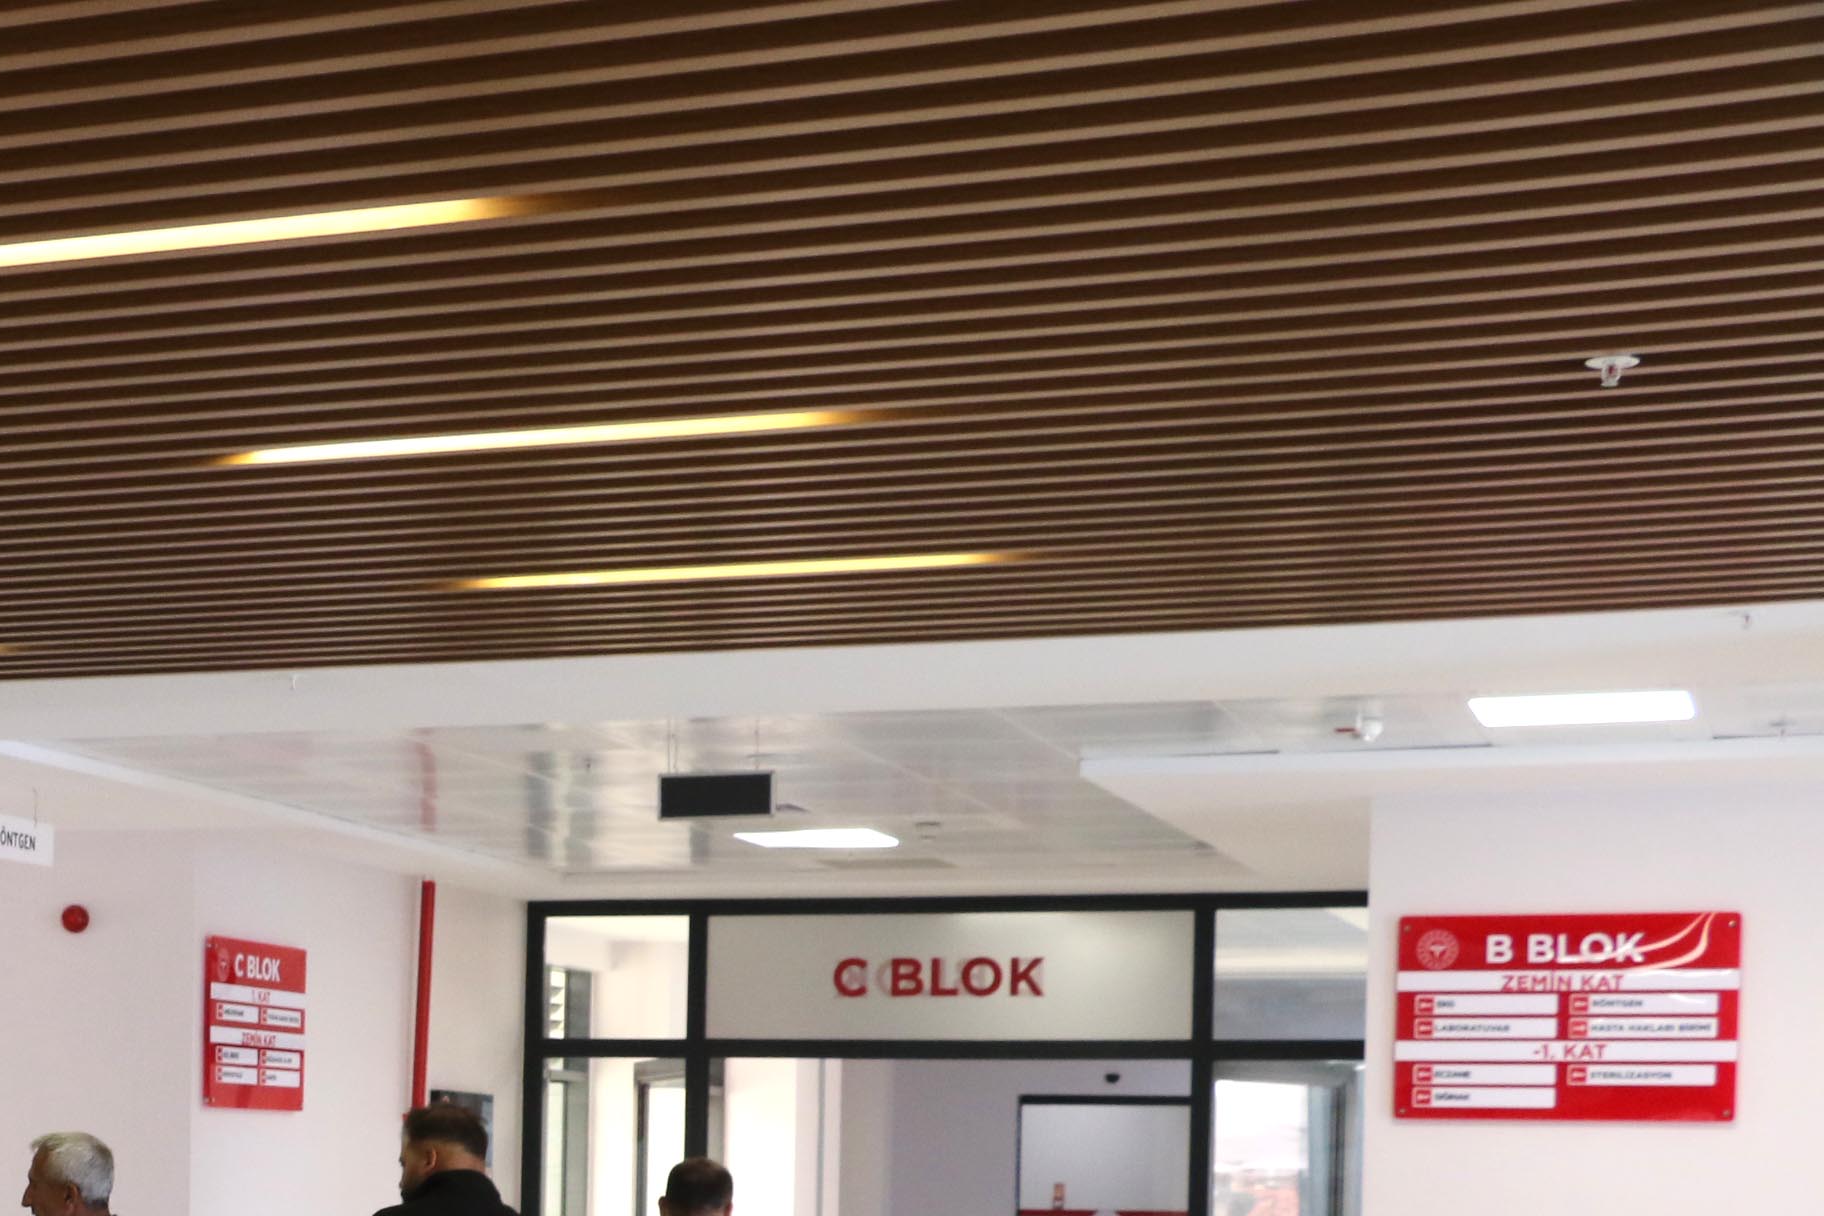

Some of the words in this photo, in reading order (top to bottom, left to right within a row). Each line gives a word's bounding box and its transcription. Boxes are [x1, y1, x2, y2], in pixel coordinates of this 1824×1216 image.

[1486, 934, 1514, 964] B
[1527, 932, 1645, 964] BLOK
[235, 953, 244, 977] C
[247, 955, 281, 982] BLOK
[833, 957, 868, 997] C
[890, 957, 1044, 997] BLOK
[1501, 970, 1571, 991] ZEMİN
[1581, 975, 1624, 991] KAT
[1563, 1044, 1607, 1059] KAT
